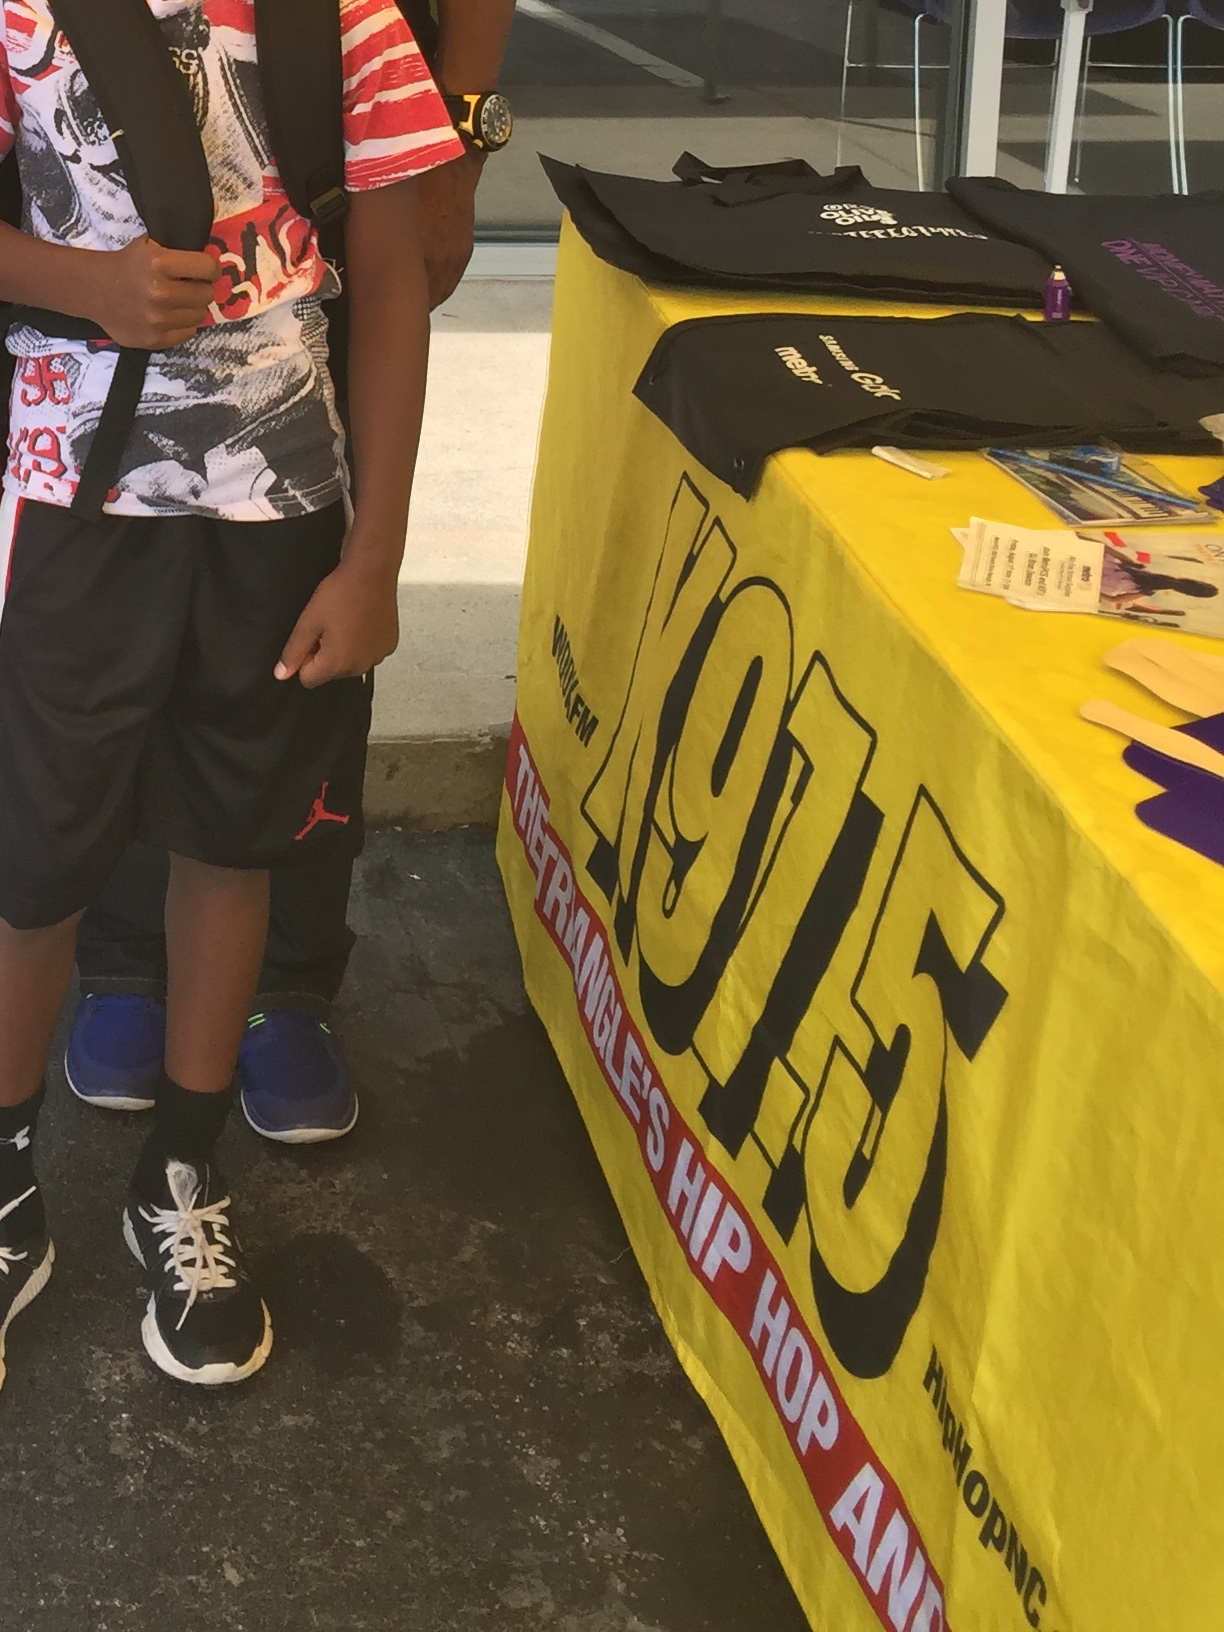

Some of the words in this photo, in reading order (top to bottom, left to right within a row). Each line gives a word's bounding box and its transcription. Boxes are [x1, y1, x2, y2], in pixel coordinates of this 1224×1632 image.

[514, 744, 549, 872] THE
[668, 1138, 751, 1282] HIP
[750, 1268, 839, 1455] HOP
